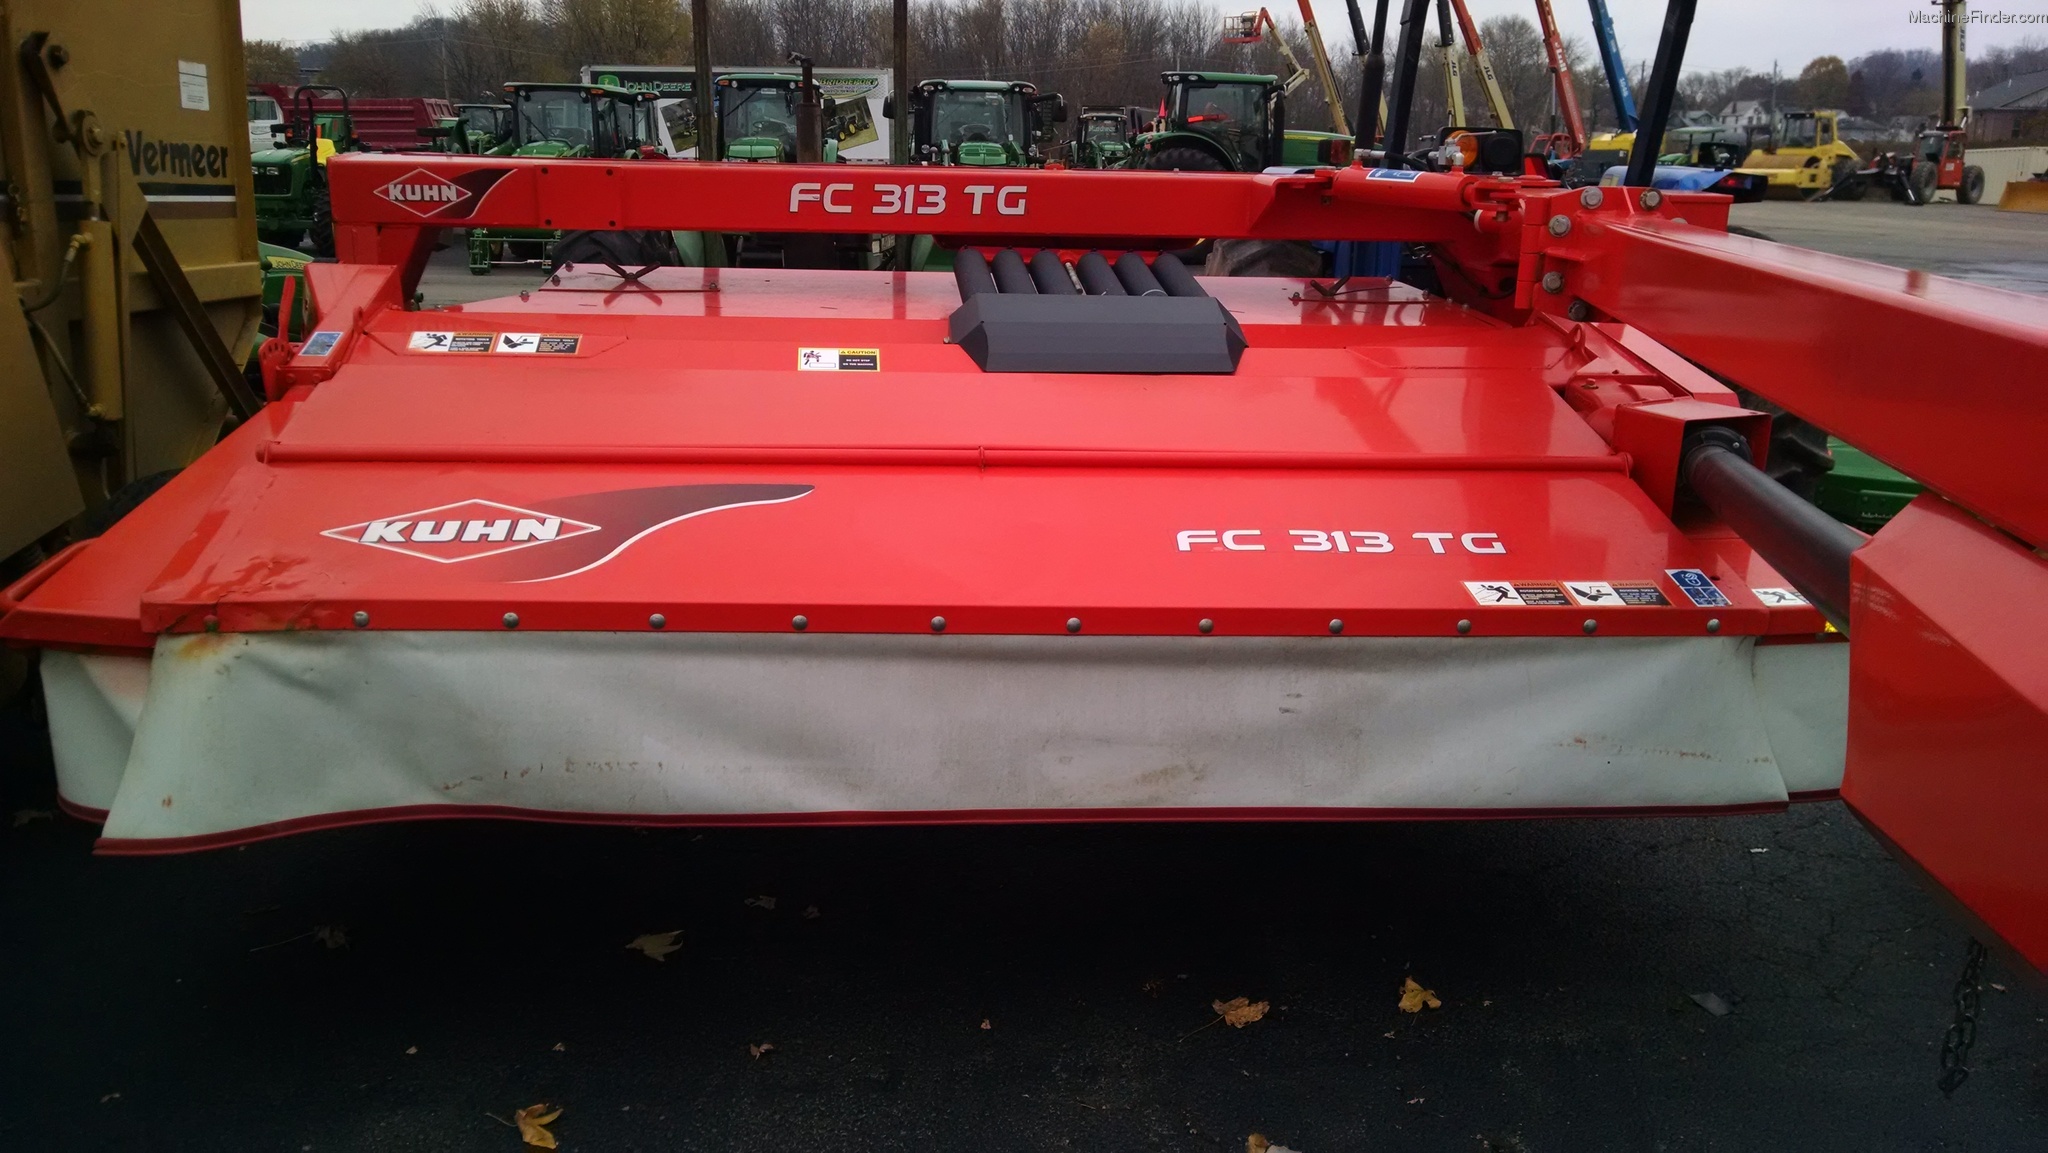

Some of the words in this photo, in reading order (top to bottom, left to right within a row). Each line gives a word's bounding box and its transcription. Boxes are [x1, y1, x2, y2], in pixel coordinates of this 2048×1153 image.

[819, 77, 877, 86] BRIDGEPORT
[1483, 65, 1494, 80] JLG
[653, 81, 692, 91] DEERE
[125, 129, 228, 178] Vermeer
[388, 184, 457, 201] KUHN
[789, 182, 854, 213] FC
[872, 183, 947, 215] 313
[963, 185, 1028, 215] TG
[359, 518, 562, 543] KUHN
[1176, 529, 1266, 552] FC
[1288, 529, 1395, 553] 313
[1411, 532, 1507, 554] TG
